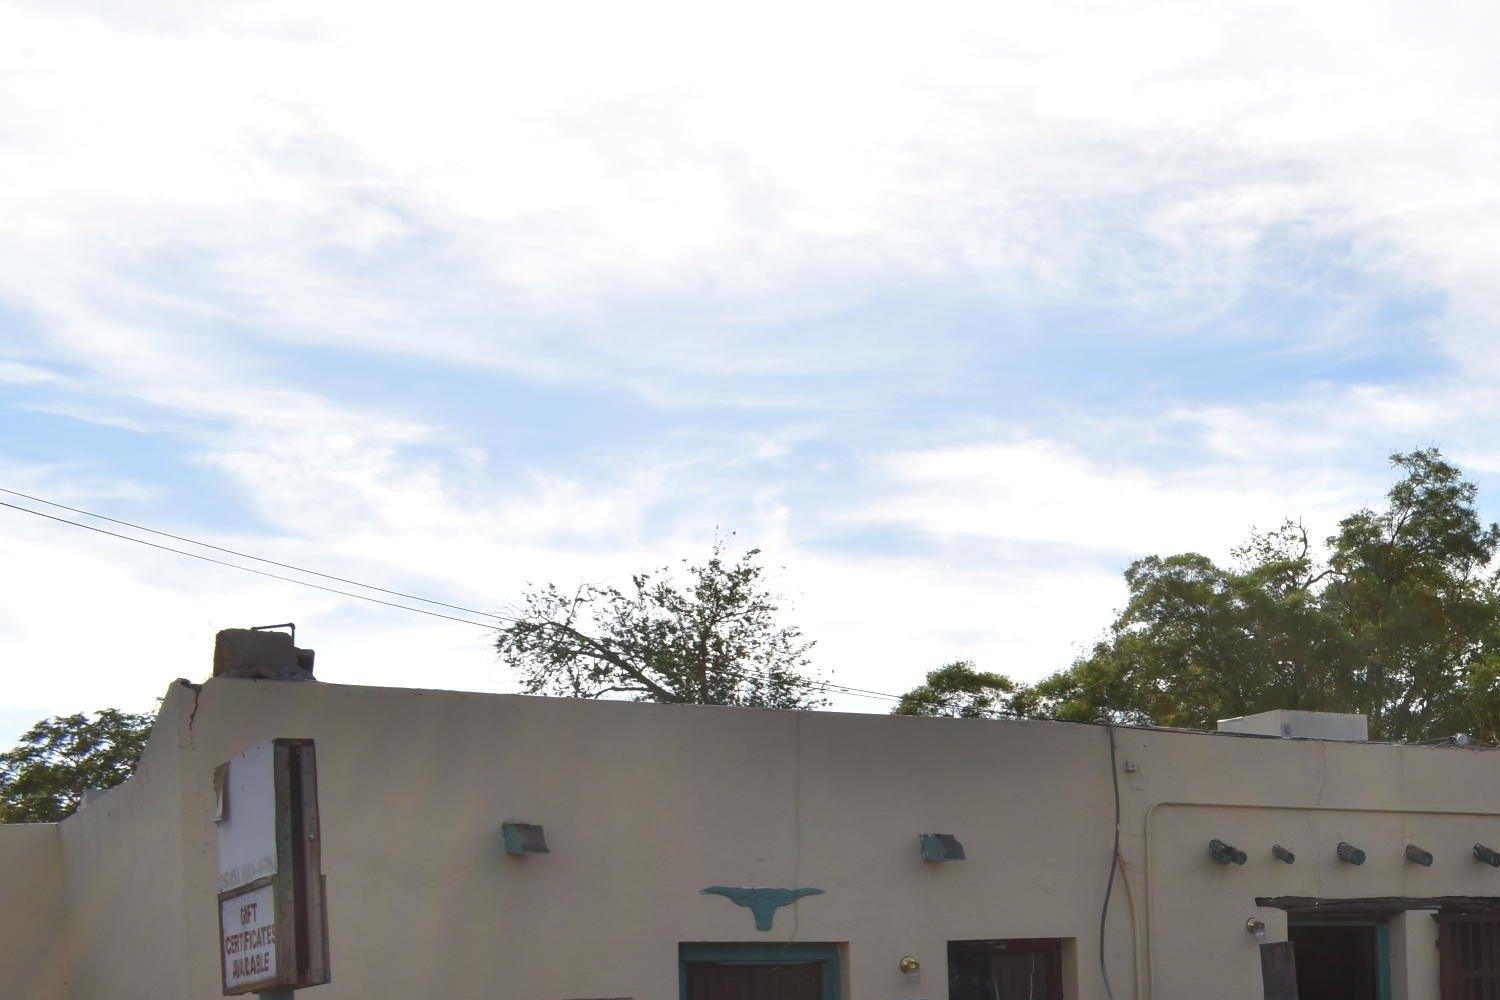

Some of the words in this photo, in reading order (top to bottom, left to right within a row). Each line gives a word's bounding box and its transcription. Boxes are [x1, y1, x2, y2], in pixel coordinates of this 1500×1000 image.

[240, 903, 257, 925] GIFT
[225, 925, 276, 954] CERTIFICATES
[233, 952, 270, 979] AVAILABLE
